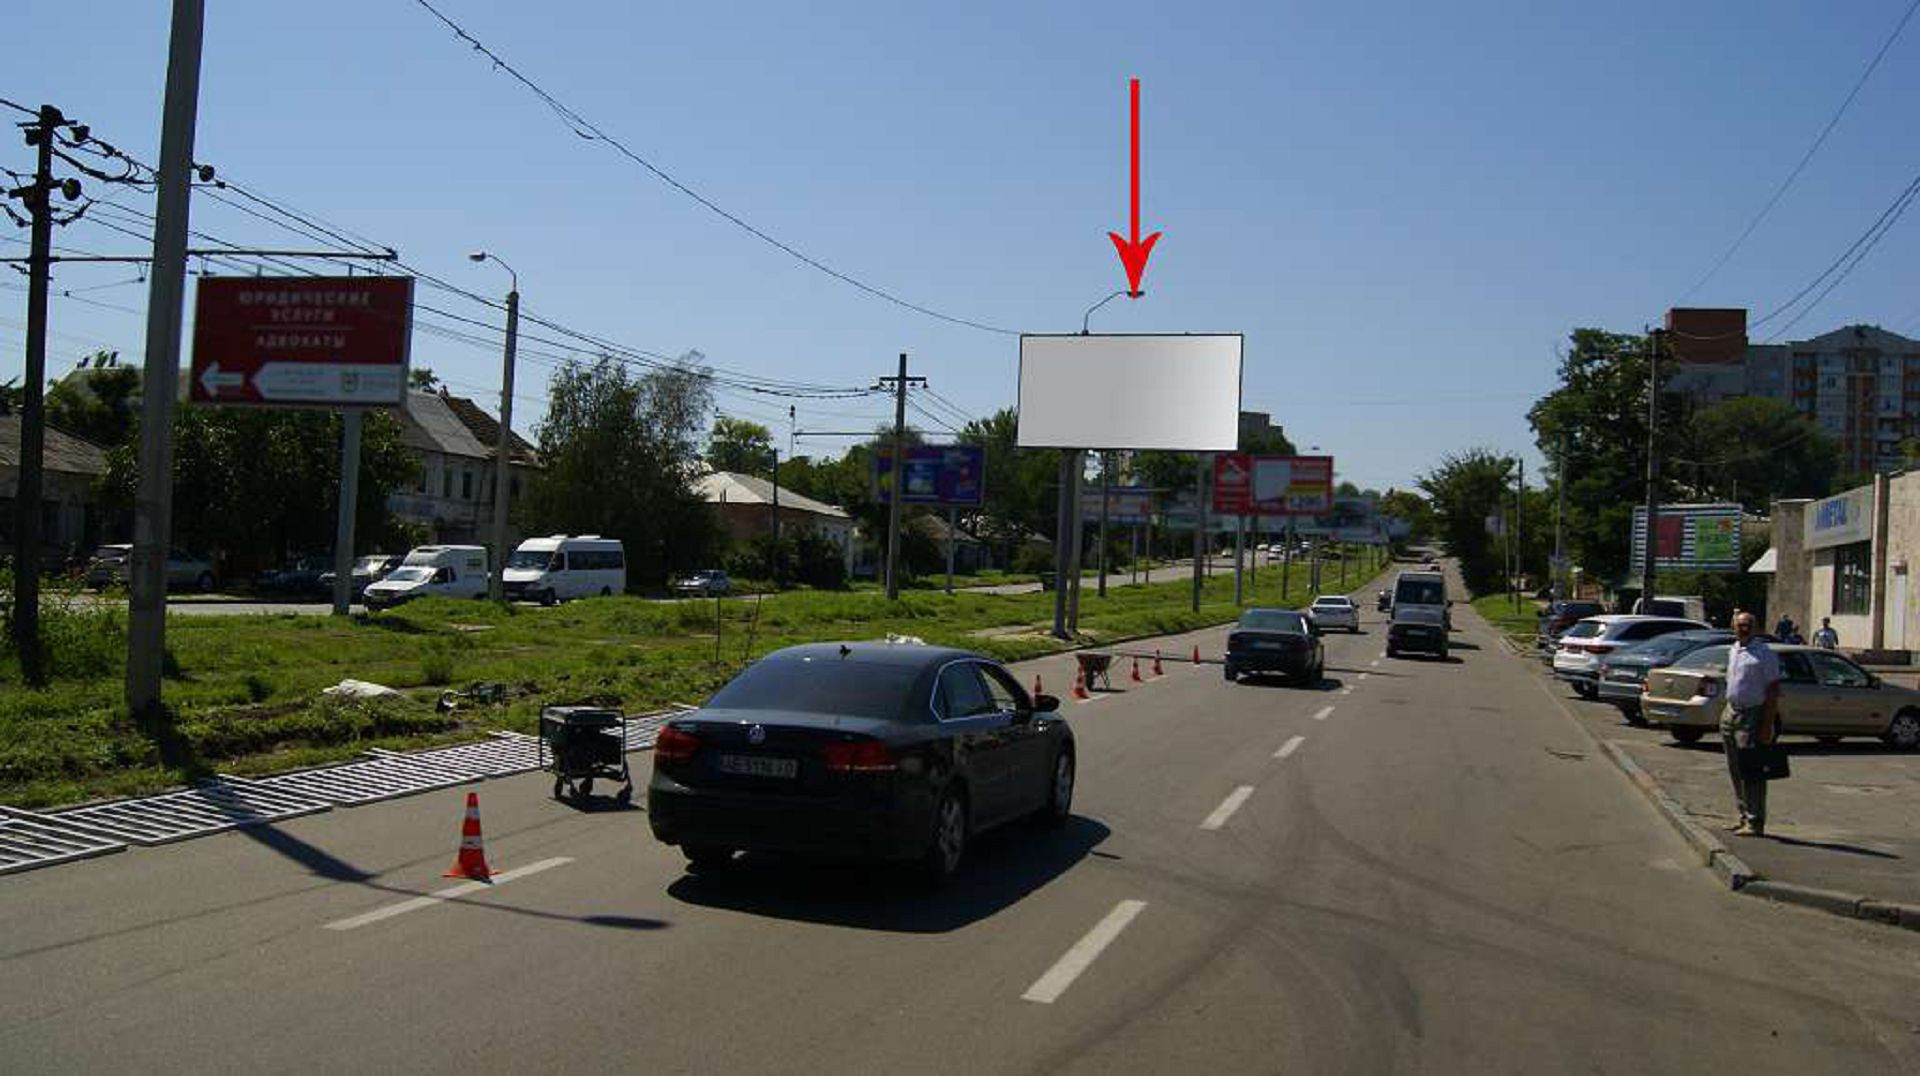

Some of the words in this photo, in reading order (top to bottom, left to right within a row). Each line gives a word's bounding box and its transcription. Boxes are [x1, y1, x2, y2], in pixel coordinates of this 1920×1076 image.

[239, 291, 371, 306] ЮРИДИЧЕСКИЕ
[270, 308, 335, 322] УСЛУГИ
[256, 334, 346, 348] АДВОКАТЫ
